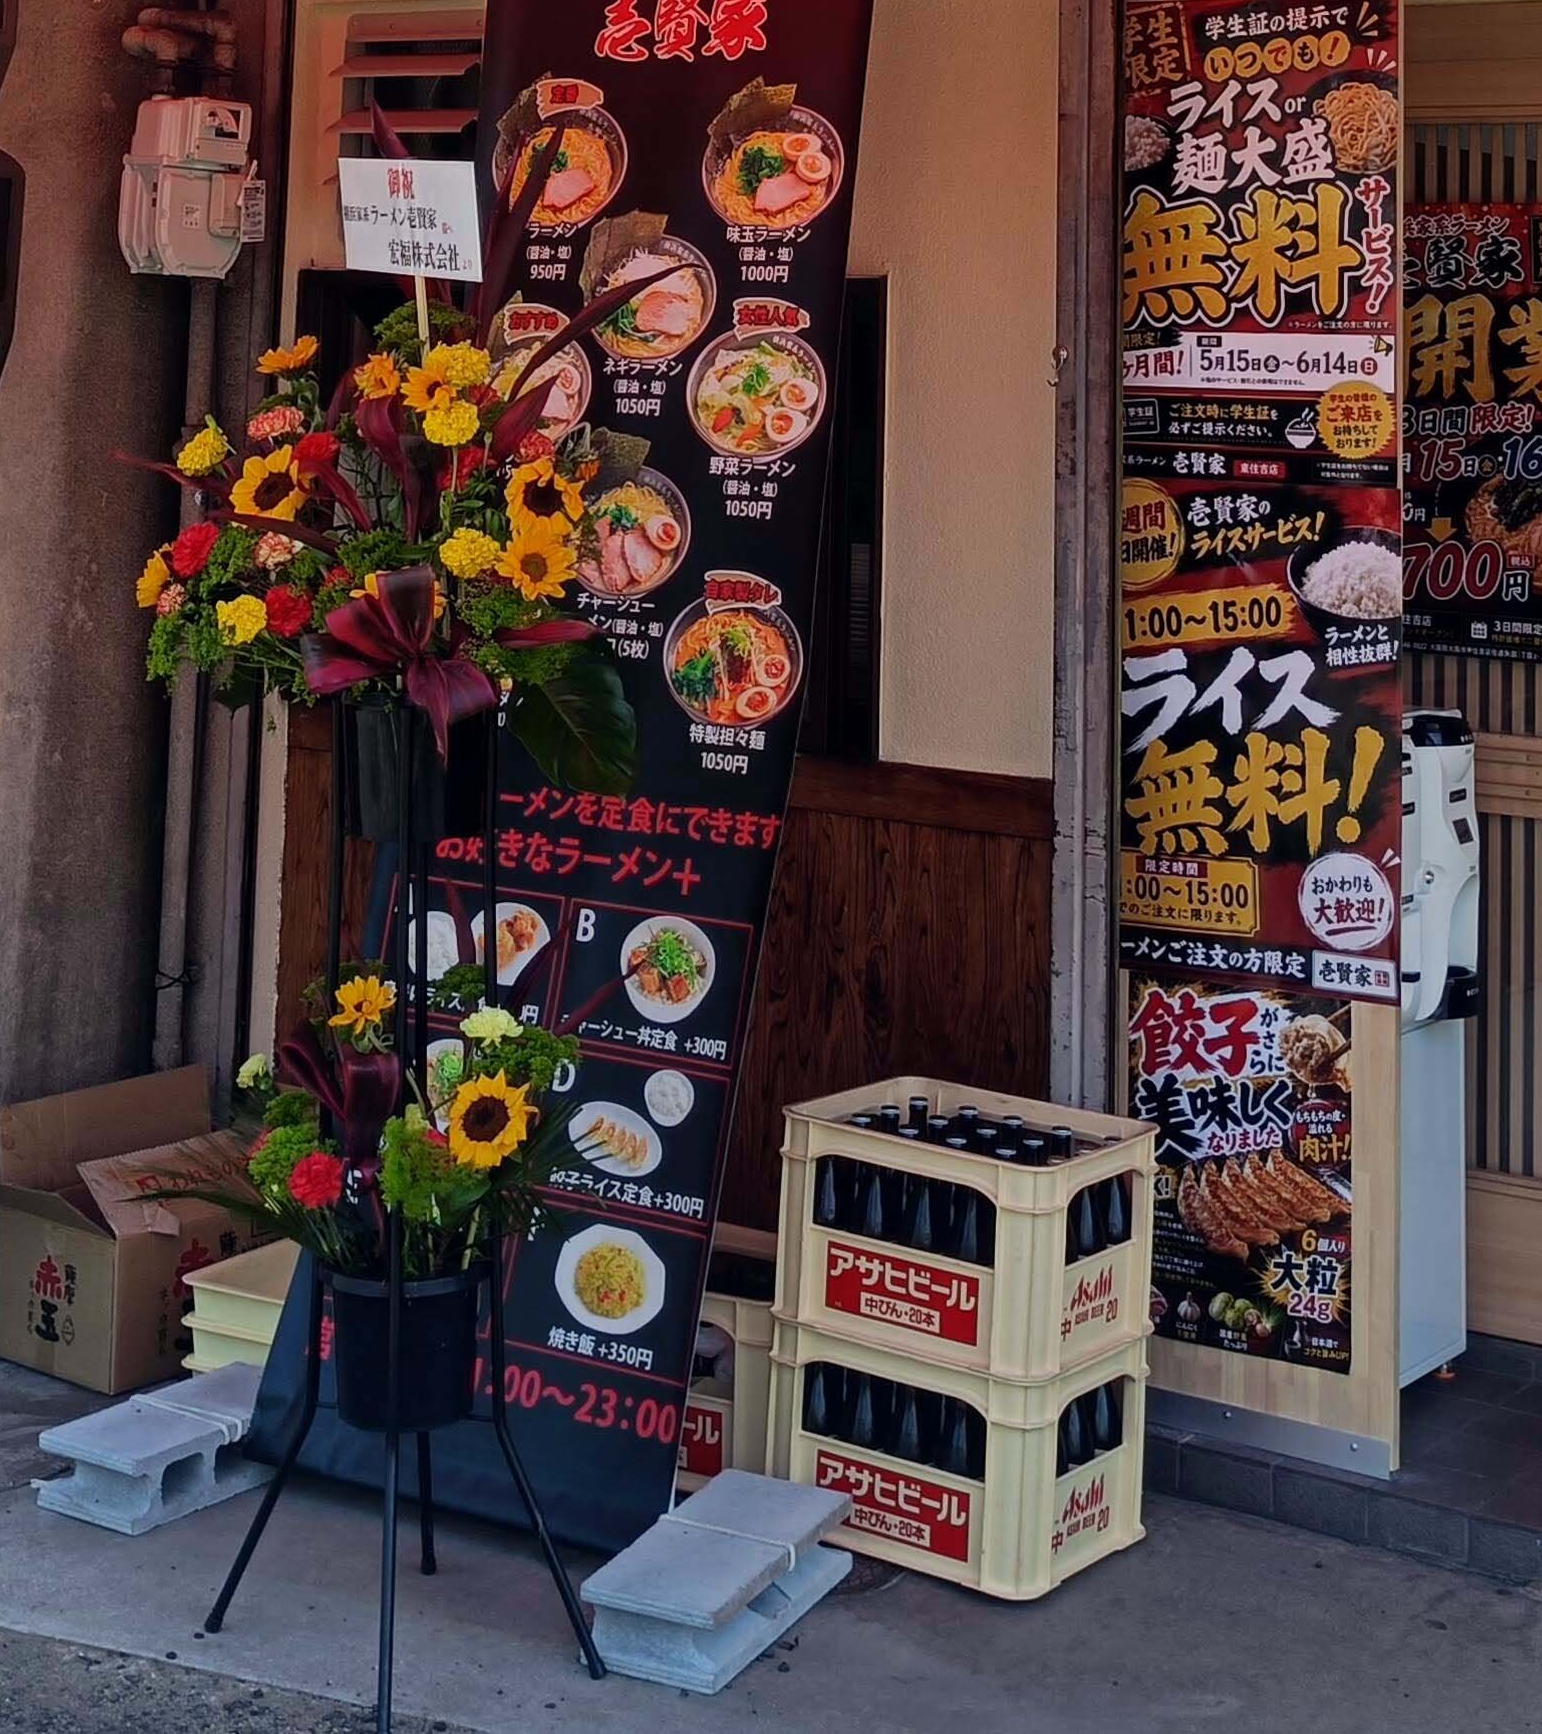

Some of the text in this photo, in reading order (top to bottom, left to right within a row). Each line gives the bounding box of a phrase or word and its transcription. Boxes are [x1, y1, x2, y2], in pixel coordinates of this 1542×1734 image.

[1205, 7, 1349, 41] 学生証の提示で
[1167, 77, 1306, 133] ライス or
[1172, 119, 1336, 197] 麺大盛
[528, 223, 578, 239] ラーメン
[726, 226, 810, 244] 味玉ラーメン
[1355, 177, 1392, 314] サービス!
[1123, 183, 1361, 324] 無料
[530, 264, 566, 281] 950円
[740, 265, 789, 283] 1000円
[603, 358, 683, 378] ネギラーメン
[615, 398, 661, 416] 1050円
[1169, 403, 1280, 420] ご注文時に学生証を
[1326, 406, 1382, 422] ご来店を
[1168, 422, 1274, 438] 必ずご提示ください。
[709, 456, 796, 479] 野菜ラーメン
[1173, 451, 1227, 476] 壱賢家
[724, 500, 772, 520] 1050円
[1187, 494, 1271, 526] 壱賢家の
[1190, 511, 1326, 558] ライスサービス!
[577, 592, 656, 613] チャーシュー
[1325, 623, 1389, 645] ラーメンと
[1326, 640, 1399, 666] 相性抜群!
[1123, 646, 1342, 754] ライス
[689, 723, 766, 751] 特製担々麺
[701, 752, 749, 774] 1050円
[1124, 725, 1385, 859] 無料!
[500, 786, 783, 850] ーメンを定食にできます
[1145, 859, 1199, 876] 限定時間
[1312, 876, 1373, 893] おかわりも
[576, 908, 596, 942] B
[1314, 899, 1385, 925] 大歓迎!
[1120, 935, 1306, 979] ーメンご注文の方限定
[1319, 960, 1373, 987] 壱賢家
[577, 1019, 728, 1062] ーシュー丼定食 +300円
[1130, 990, 1260, 1077] 餃子
[1139, 1073, 1295, 1161] 美味しく
[1207, 1128, 1281, 1153] なりました
[1301, 1228, 1346, 1254] 6個入り
[830, 1247, 978, 1312] アサヒビール
[1070, 1264, 1113, 1312] Asahi
[1271, 1252, 1341, 1296] 大粒
[864, 1295, 937, 1330] 中びん・20本
[1060, 1317, 1072, 1343] 中
[1106, 1297, 1118, 1324] 20
[1289, 1292, 1332, 1322] 24g
[547, 1326, 654, 1372] 焼き飯 +350円
[820, 1456, 967, 1528] アサヒビール
[1061, 1472, 1105, 1525] Asahi
[855, 1506, 927, 1542] 中びん・20本
[1052, 1530, 1063, 1555] 中
[1097, 1505, 1110, 1532] 20
